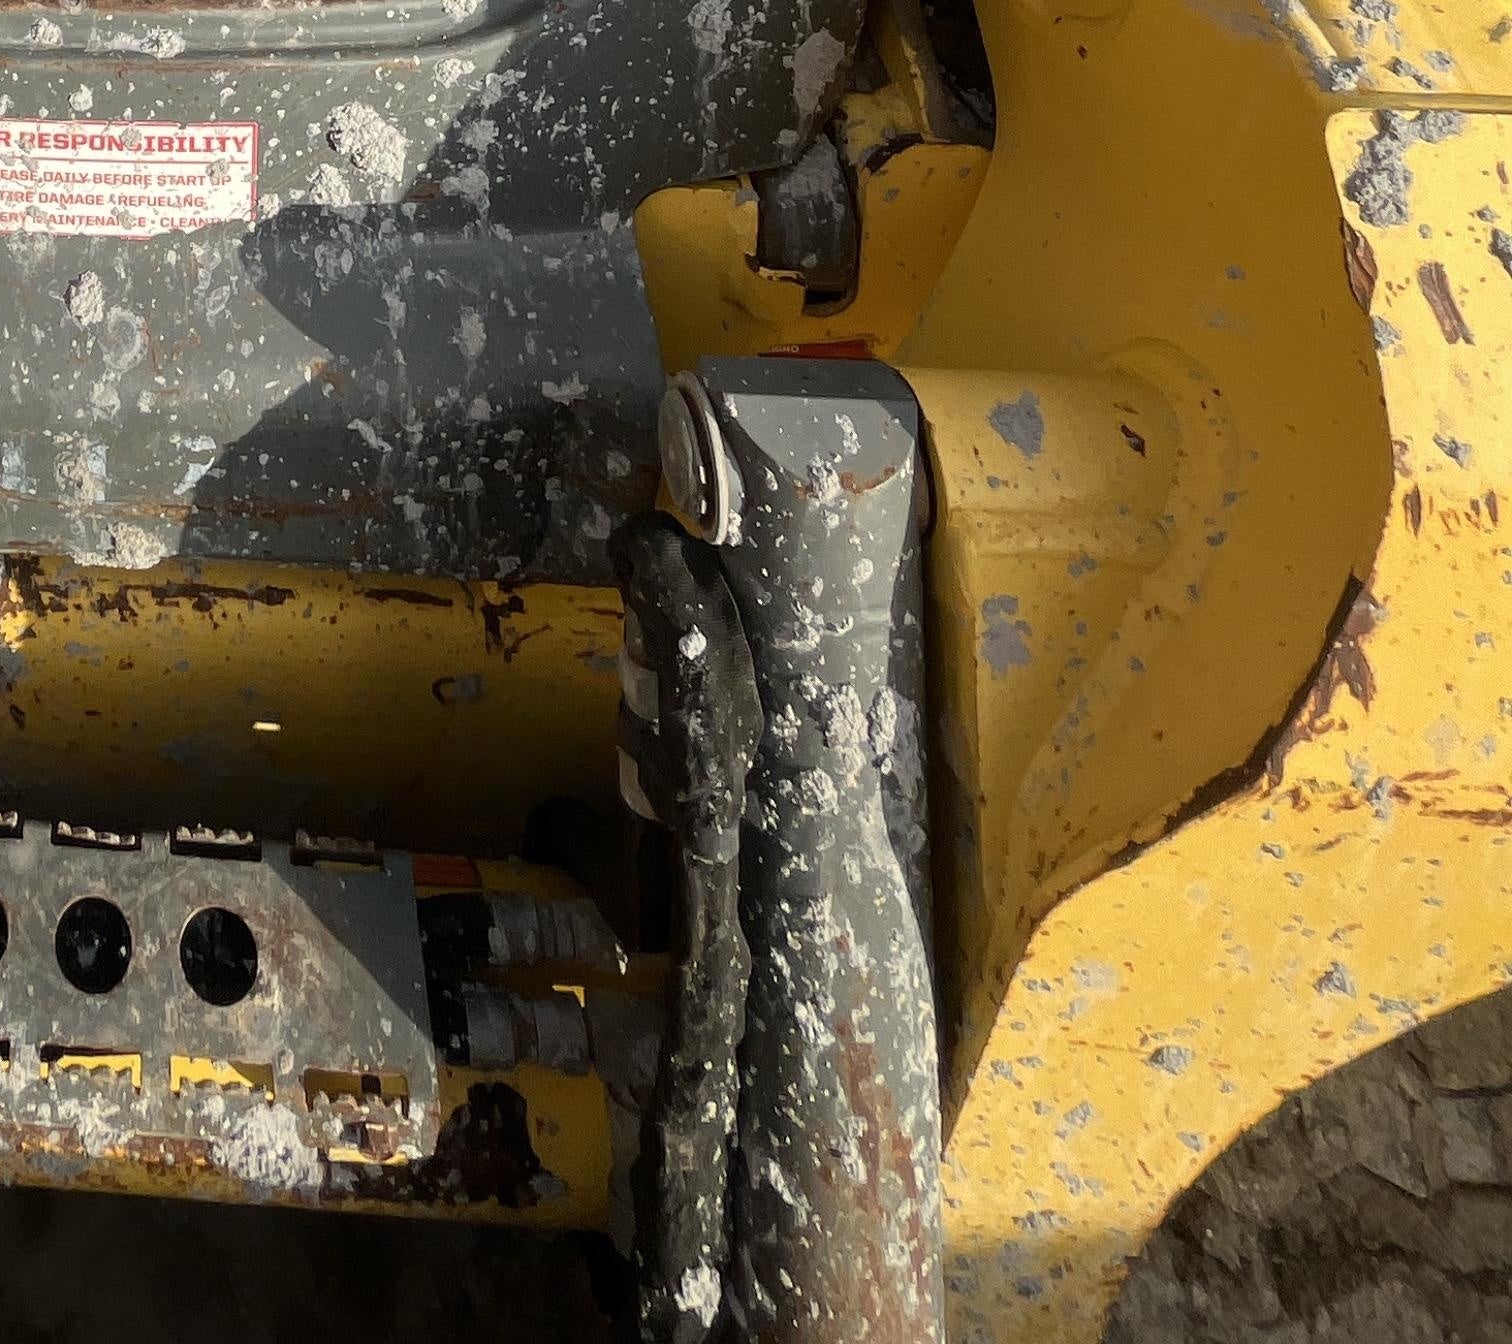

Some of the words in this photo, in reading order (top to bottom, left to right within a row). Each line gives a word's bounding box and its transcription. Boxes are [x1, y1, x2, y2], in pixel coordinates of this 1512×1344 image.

[43, 171, 88, 184] DAILY
[93, 173, 152, 186] BEFORE
[157, 175, 206, 187] START
[38, 192, 104, 205] DAMAGE
[118, 194, 205, 208] REFUELING
[31, 213, 147, 227] AINTENAE
